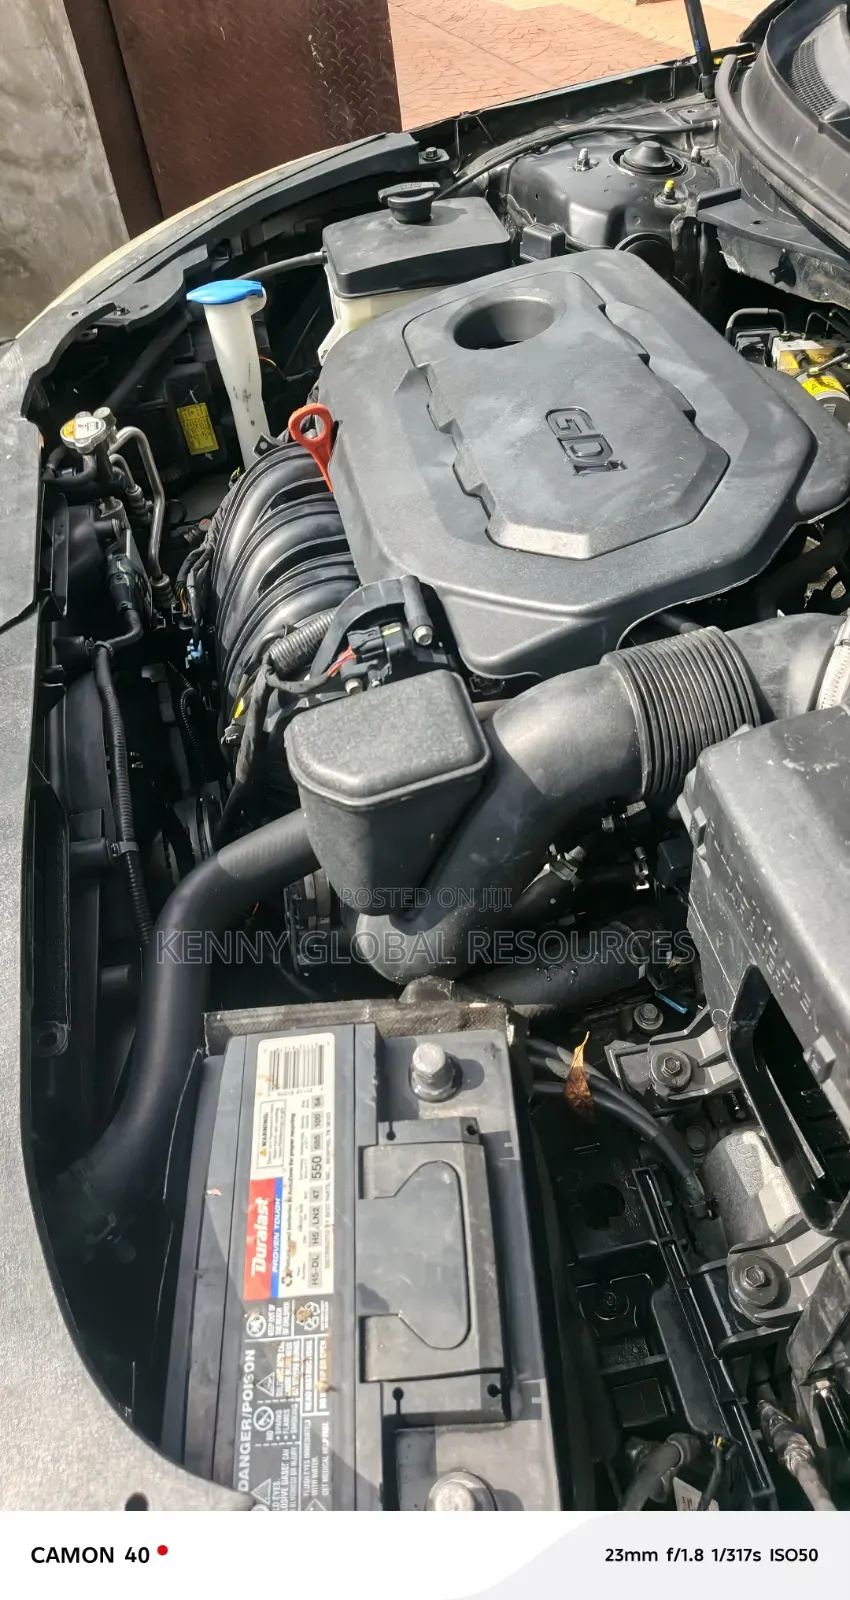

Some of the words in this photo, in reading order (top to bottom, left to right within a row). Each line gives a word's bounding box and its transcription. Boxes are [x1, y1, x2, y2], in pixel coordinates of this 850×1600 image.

[314, 1097, 321, 1106] 54
[311, 1156, 322, 1180] 550
[312, 1190, 320, 1200] 47
[273, 1198, 282, 1230] TOUGH
[312, 1207, 320, 1226] LN2
[251, 1197, 269, 1277] Duralast
[312, 1232, 320, 1244] H5
[272, 1232, 280, 1273] PROVEN
[312, 1255, 320, 1286] H5-DL
[238, 1349, 256, 1492] DANGER/POISON
[266, 1430, 274, 1440] NO
